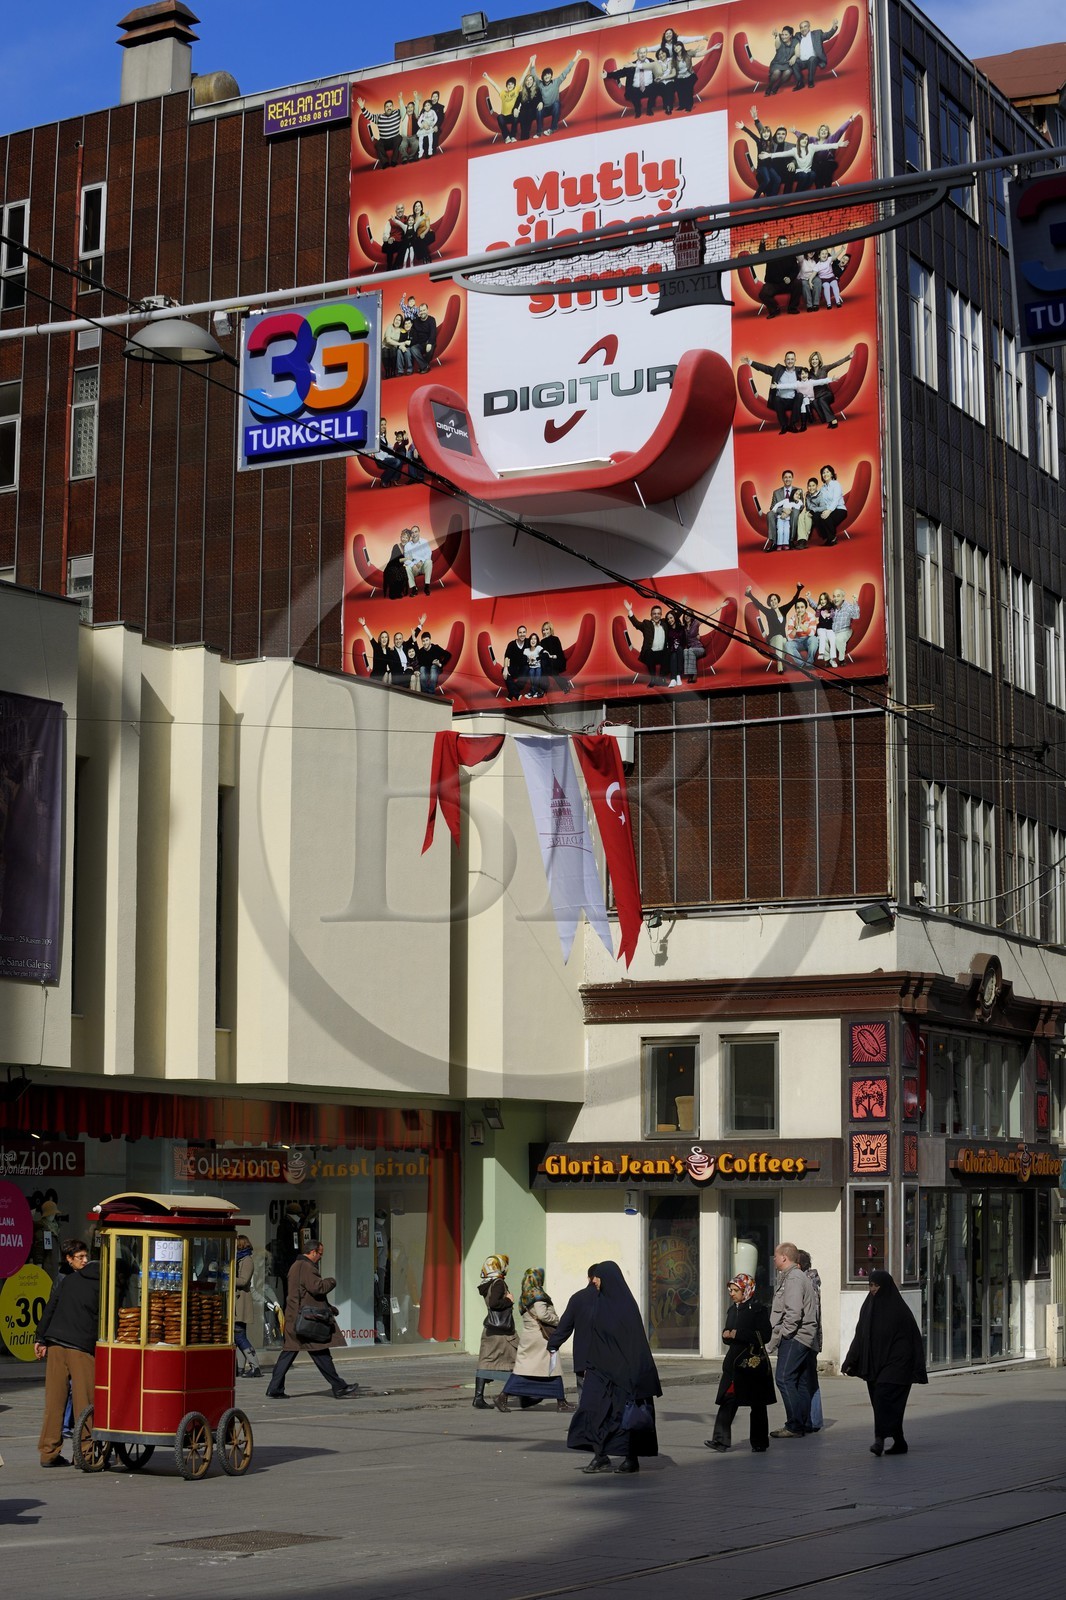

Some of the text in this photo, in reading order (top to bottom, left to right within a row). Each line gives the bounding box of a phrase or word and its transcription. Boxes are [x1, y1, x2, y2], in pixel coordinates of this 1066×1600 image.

[268, 88, 343, 121] REKLAM 2010
[279, 109, 332, 128] 0212 358 08 61
[513, 152, 680, 217] Mutlu
[246, 303, 370, 417] 3G
[483, 364, 678, 417] DIGITUR
[248, 416, 358, 451] TURKCELL
[436, 421, 468, 438] DIGITURK
[7, 956, 25, 967] Sanat
[26, 958, 52, 970] Galerisi
[1, 1144, 77, 1171] lezione
[187, 1152, 280, 1177] collezione
[545, 1152, 805, 1175] Gloria Jean's Coffees
[963, 1148, 994, 1173] Gloria
[1031, 1152, 1062, 1175] Coffees
[161, 1250, 174, 1260] SU
[9, 1331, 36, 1346] indiri
[341, 1328, 378, 1339] one.com
